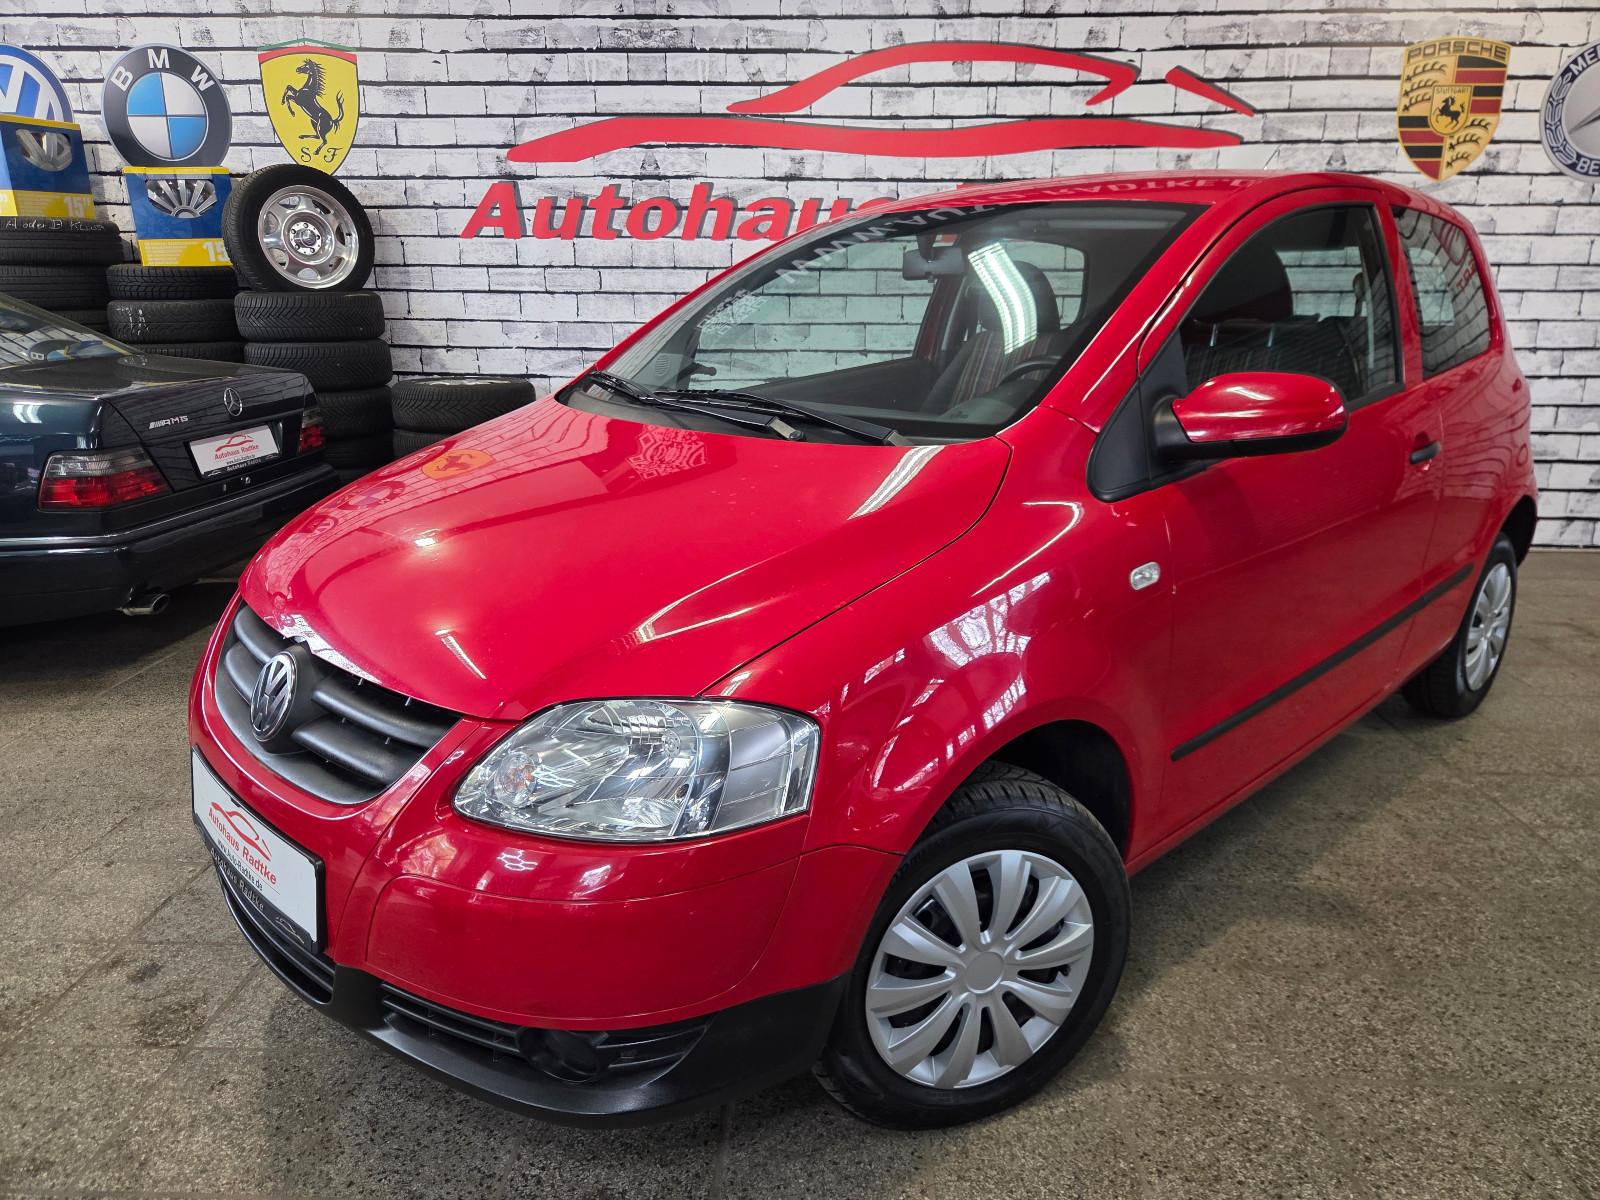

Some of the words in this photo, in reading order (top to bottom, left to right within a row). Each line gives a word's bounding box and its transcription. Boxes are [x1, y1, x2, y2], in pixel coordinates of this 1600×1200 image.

[110, 48, 215, 92] BMW
[1407, 41, 1507, 64] PORSCHE
[1569, 45, 1600, 75] ME
[1435, 87, 1469, 95] STUTTGART
[460, 181, 893, 242] Autohau
[214, 449, 240, 460] Autohaus
[208, 806, 240, 852] Autohaus
[242, 846, 277, 885] Radtke
[210, 847, 238, 885] Autohaus
[239, 880, 264, 912] Radtke
